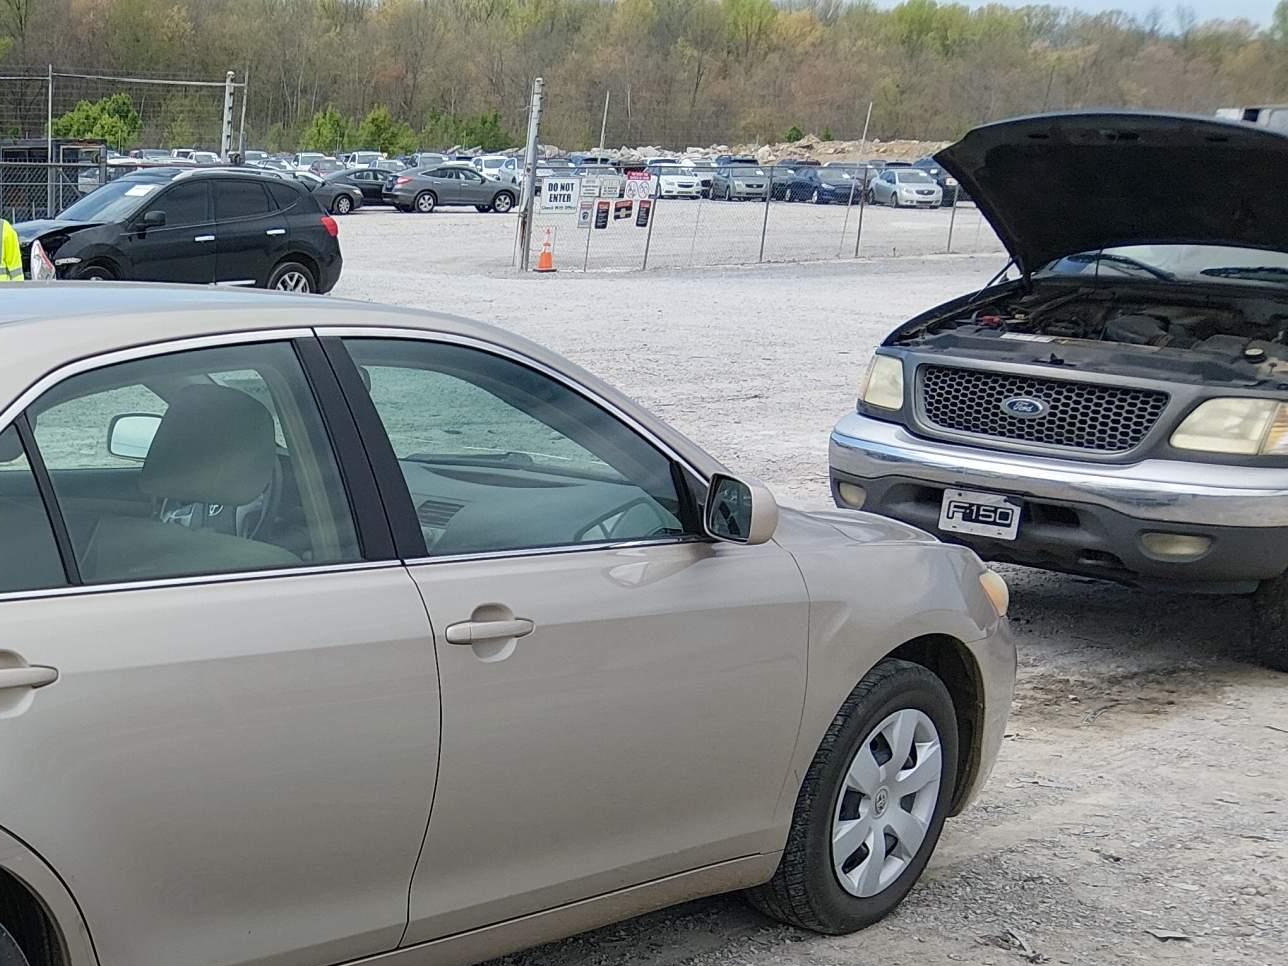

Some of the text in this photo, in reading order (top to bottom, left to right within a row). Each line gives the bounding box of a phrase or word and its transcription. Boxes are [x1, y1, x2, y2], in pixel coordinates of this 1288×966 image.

[548, 182, 559, 192] DO
[560, 182, 575, 192] NOT
[548, 193, 572, 203] ENTER
